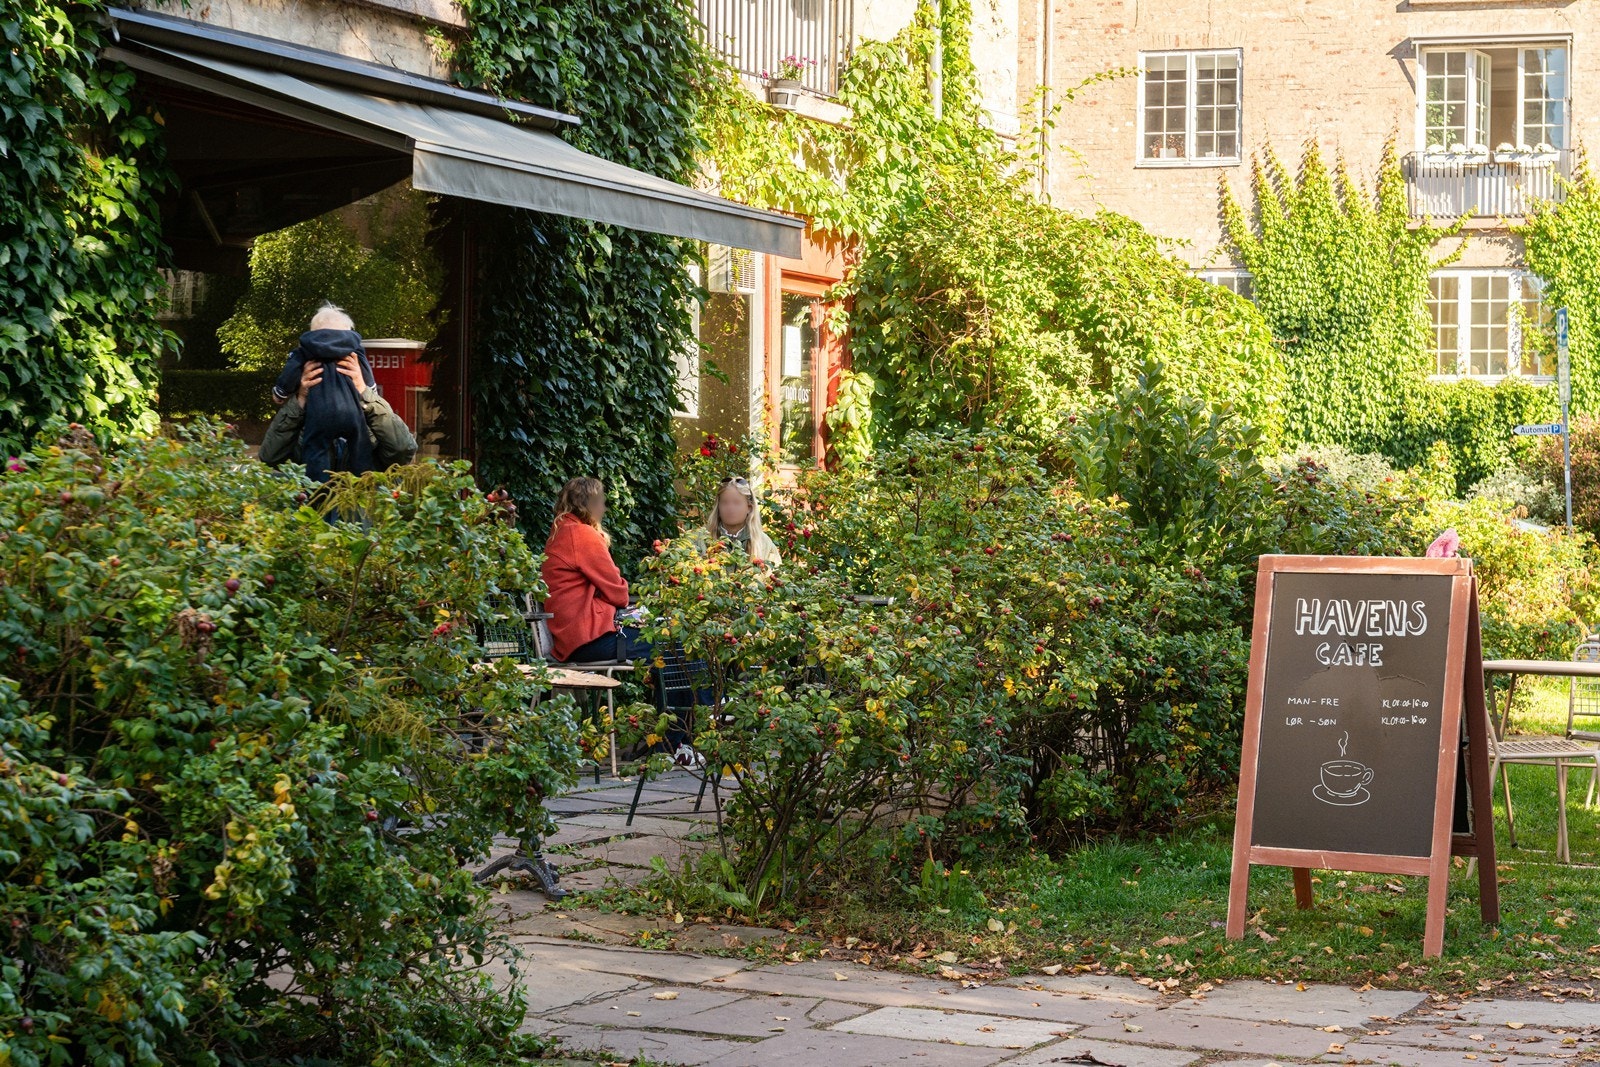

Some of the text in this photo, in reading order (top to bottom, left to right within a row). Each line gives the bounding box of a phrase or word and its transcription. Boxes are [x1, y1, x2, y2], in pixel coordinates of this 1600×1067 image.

[1520, 426, 1551, 434] Automat
[1295, 598, 1428, 636] HAVENS
[1315, 642, 1384, 666] CAFE
[1320, 697, 1340, 707] FRE
[1285, 717, 1303, 726] LØR
